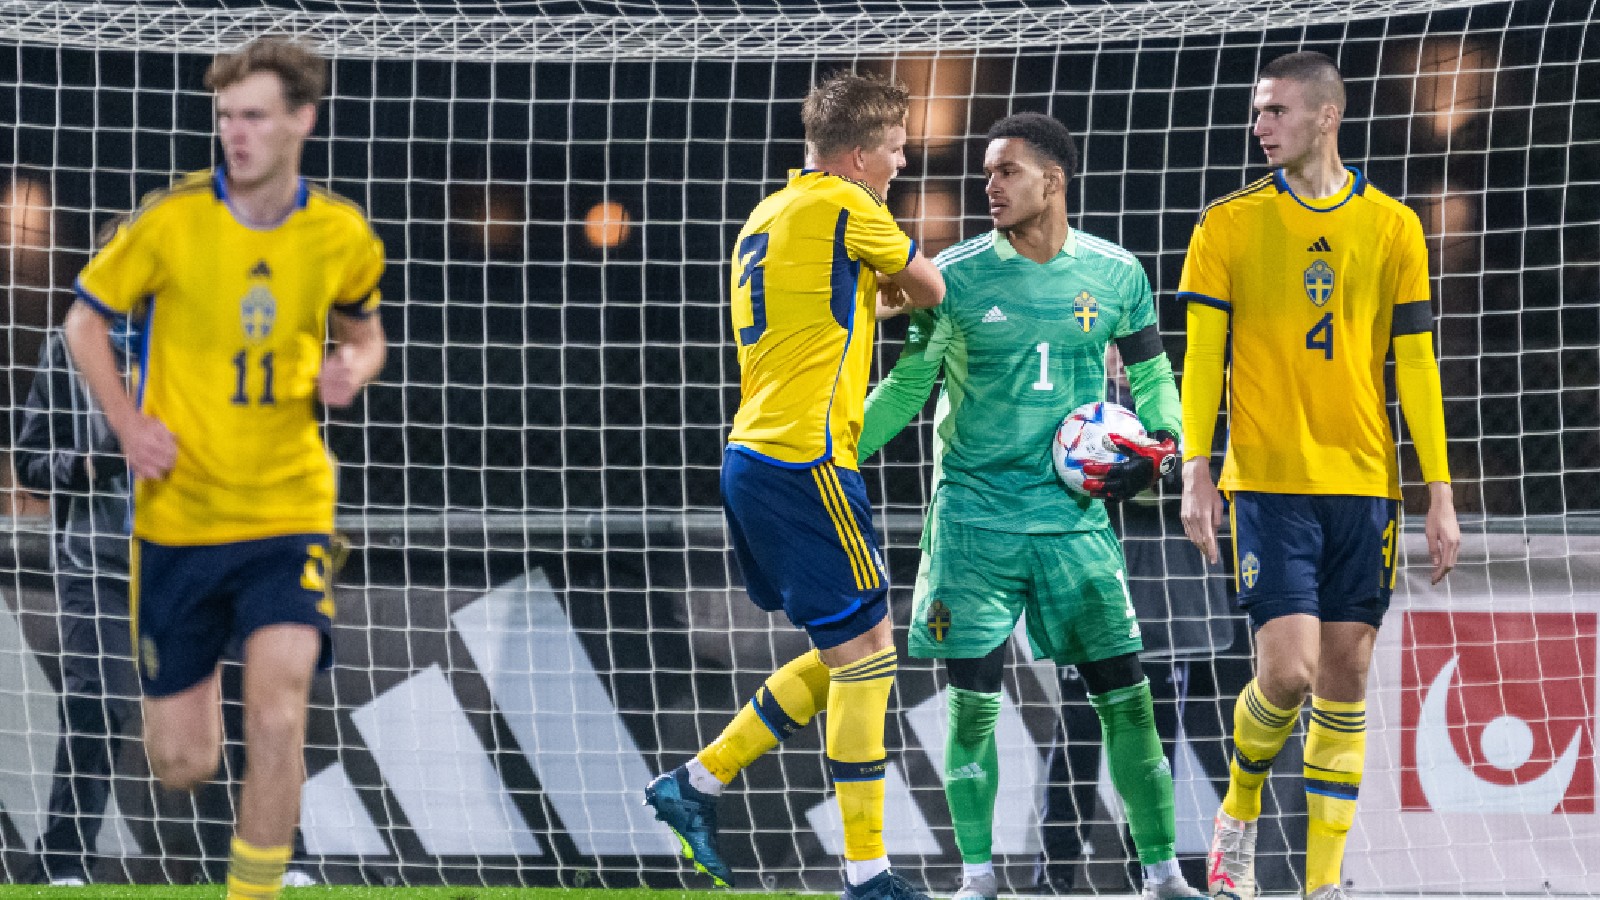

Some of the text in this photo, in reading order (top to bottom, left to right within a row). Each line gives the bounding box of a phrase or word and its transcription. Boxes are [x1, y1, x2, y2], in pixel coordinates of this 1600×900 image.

[738, 232, 769, 346] 3
[1305, 311, 1334, 360] 4
[231, 350, 275, 405] 11
[1032, 342, 1054, 391] 1
